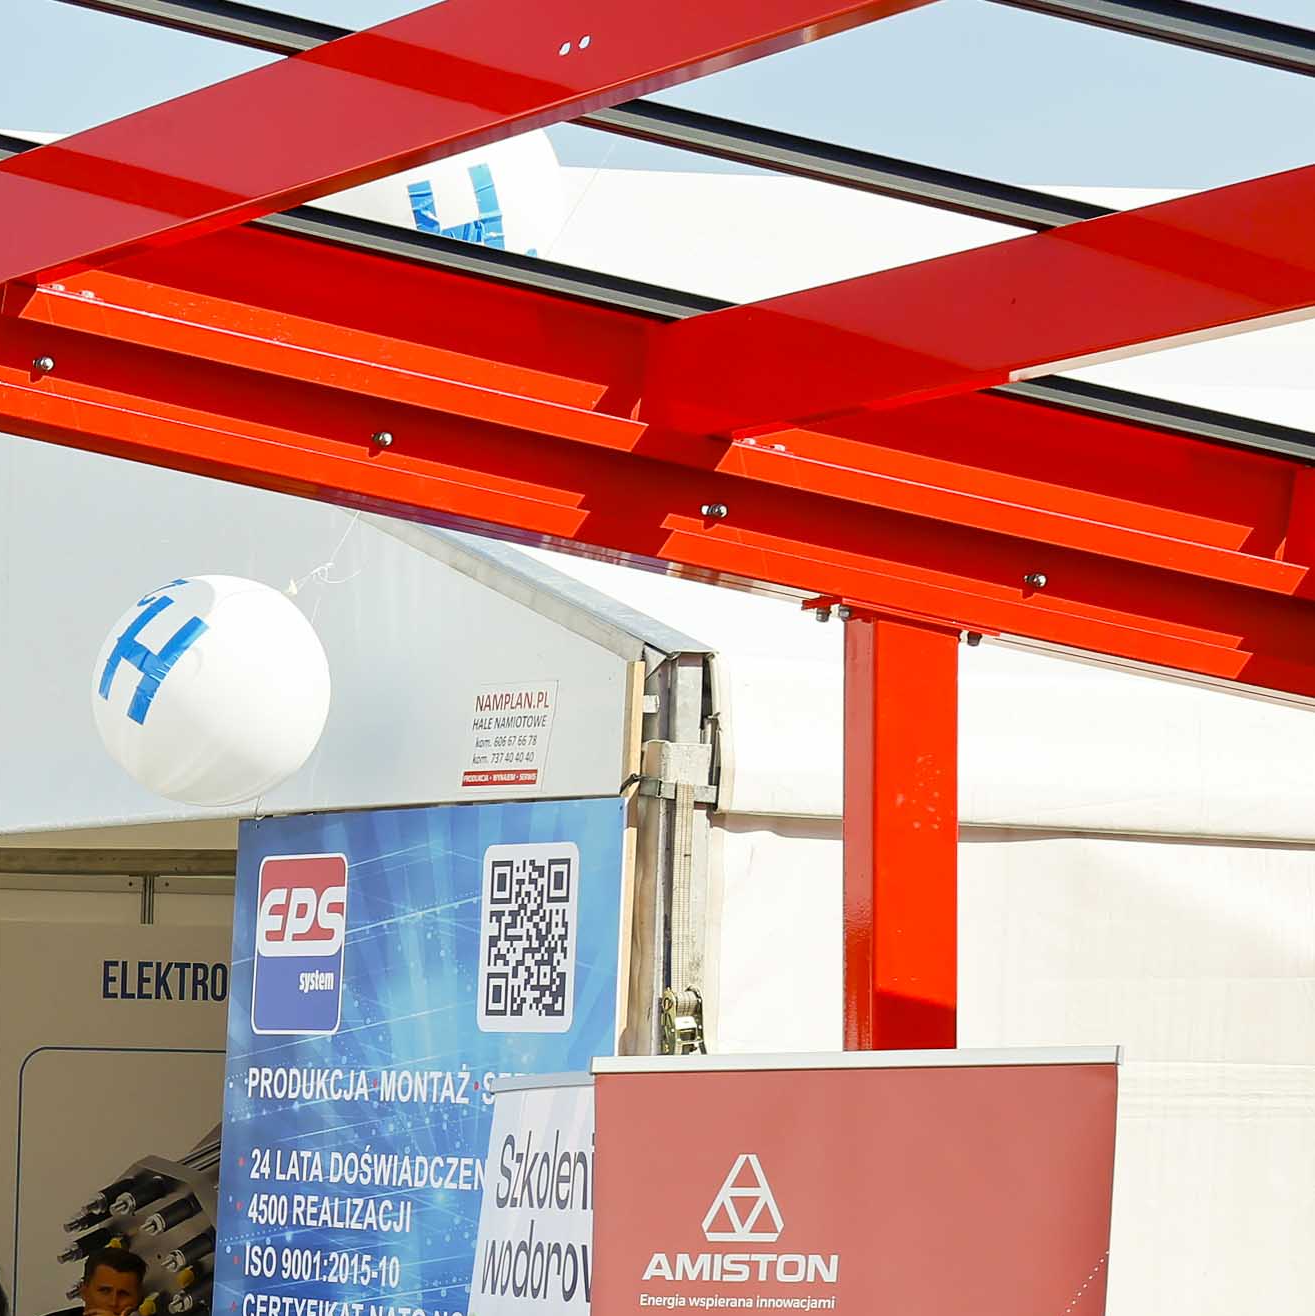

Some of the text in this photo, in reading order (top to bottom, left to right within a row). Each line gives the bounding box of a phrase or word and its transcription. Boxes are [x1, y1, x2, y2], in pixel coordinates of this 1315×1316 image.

[476, 691, 549, 712] NAMPLAN.PL
[473, 714, 548, 730] HALE NAMIOTOWE
[258, 886, 346, 957] EPS
[299, 970, 334, 993] system
[248, 1067, 368, 1102] PRODUKCJA
[379, 1064, 469, 1104] MONTAŻ
[250, 1148, 271, 1180] 24
[275, 1150, 324, 1183] LATA
[248, 1194, 412, 1233] 4500 REALIZACJI
[244, 1244, 401, 1288] ISO 9001:2015-10
[641, 1253, 839, 1283] AMISTON
[639, 1294, 835, 1311] Energia wspierana innowacjami
